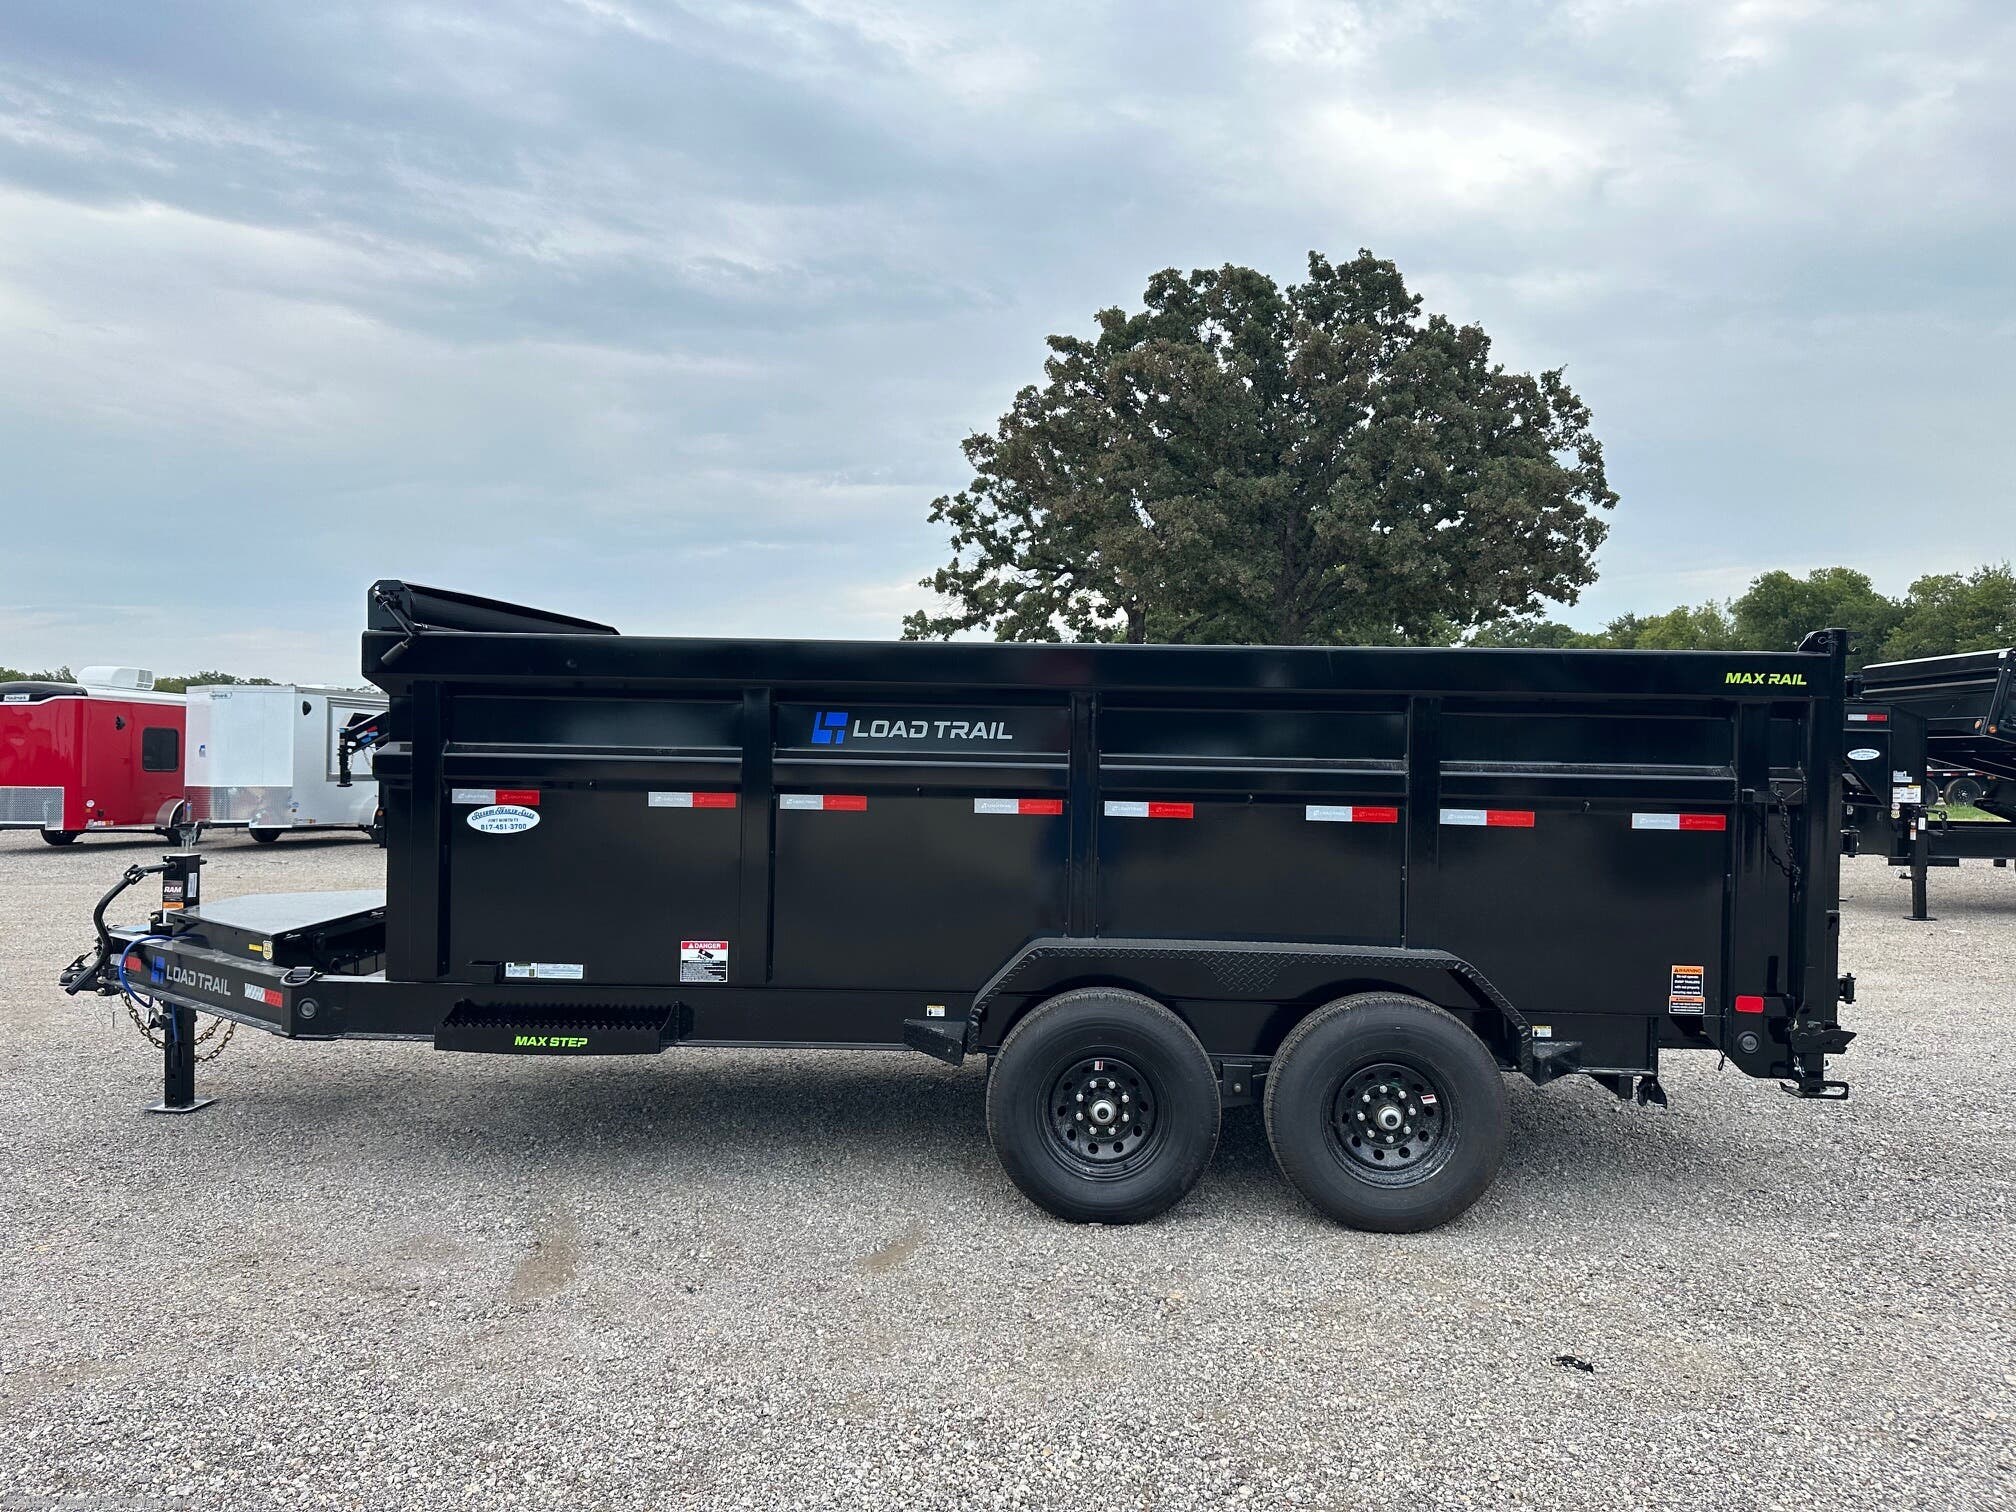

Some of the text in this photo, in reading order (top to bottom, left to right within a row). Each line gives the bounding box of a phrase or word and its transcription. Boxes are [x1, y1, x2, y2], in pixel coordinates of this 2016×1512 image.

[1725, 672, 1808, 686] MAX RAIL
[852, 719, 1013, 740] LOAD TRAIL
[166, 965, 231, 996] LOAD TRAIL
[514, 1036, 588, 1048] MAX STEP
